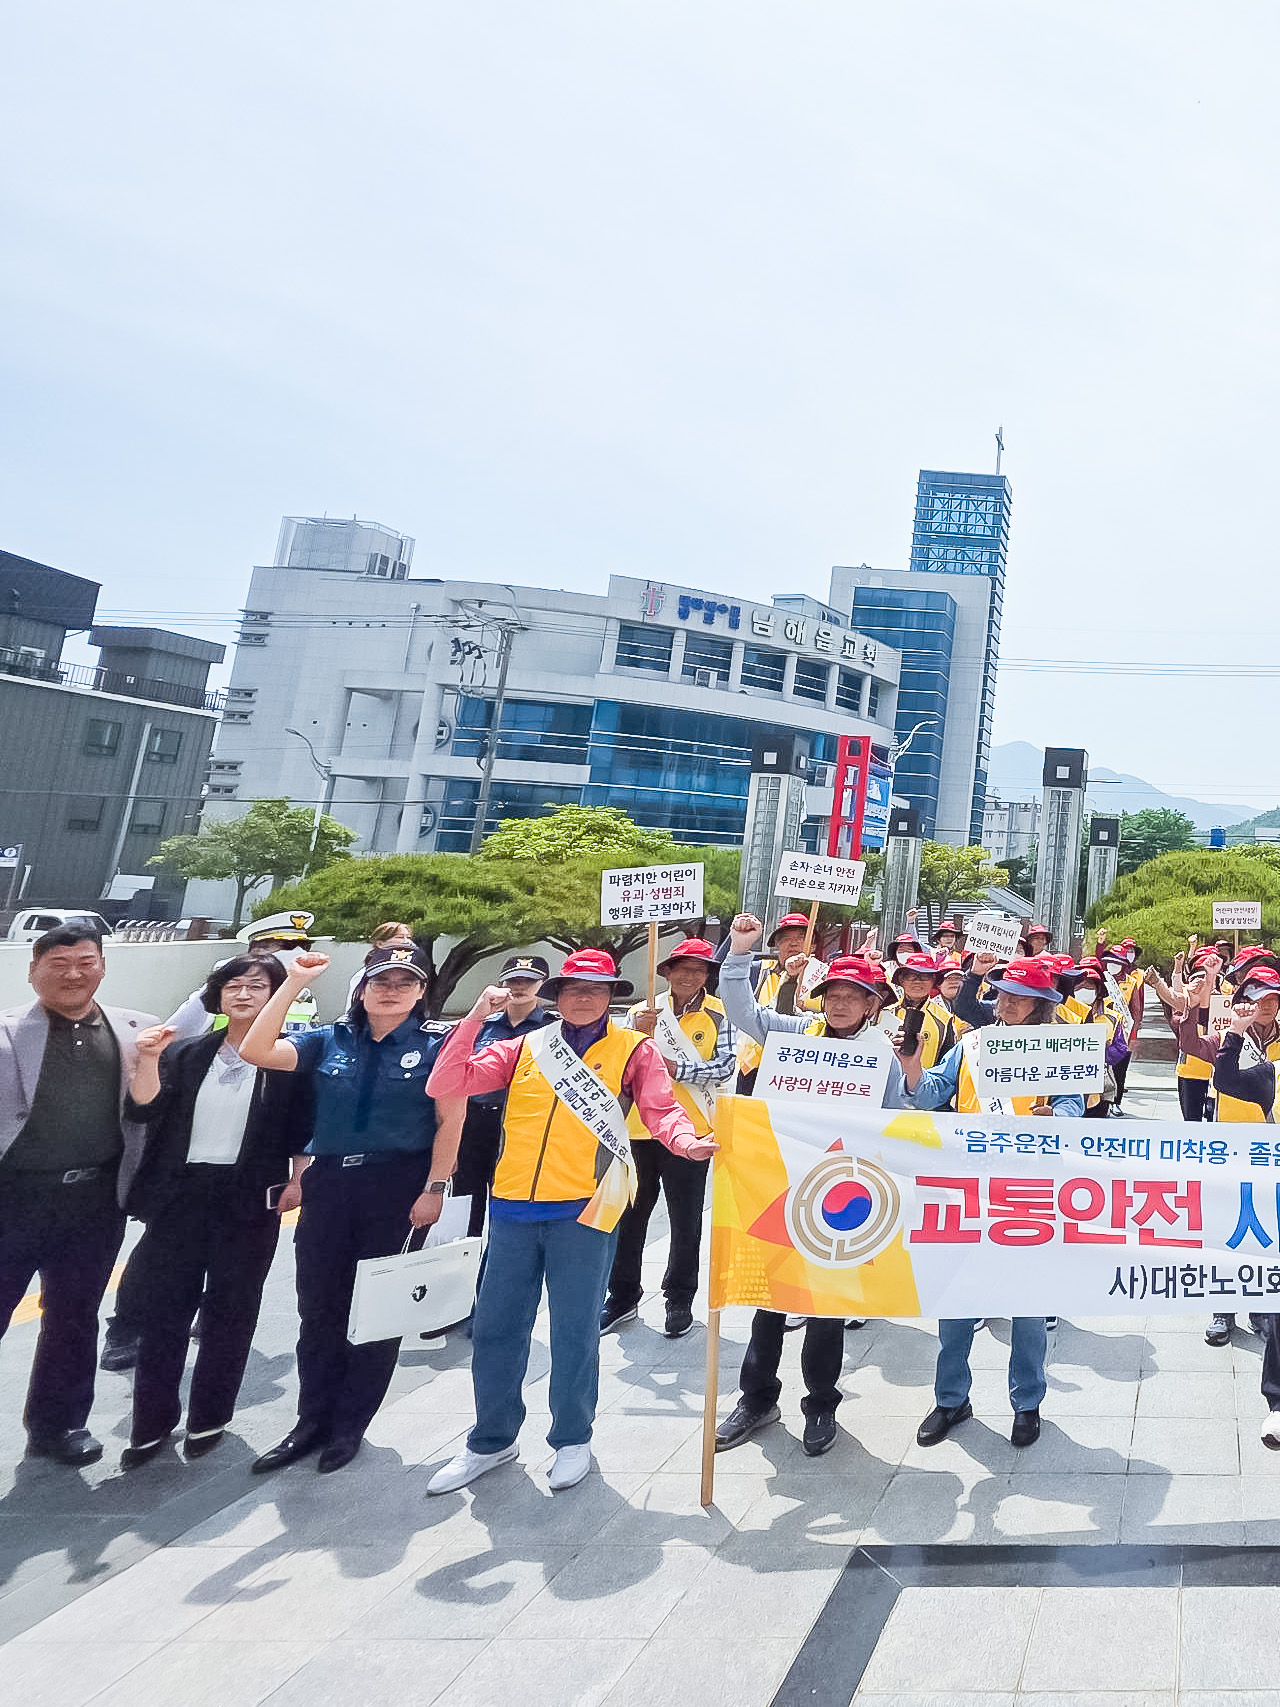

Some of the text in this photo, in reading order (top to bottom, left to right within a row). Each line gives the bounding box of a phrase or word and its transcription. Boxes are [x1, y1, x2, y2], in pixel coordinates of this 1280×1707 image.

[608, 868, 697, 887] 파렴치한 어린이
[788, 859, 856, 880] 손자·손녀 안전
[619, 887, 686, 902] 유괴·성범죄
[779, 876, 859, 897] 우리손으로 지키자!
[608, 901, 698, 919] 행위를 근절하자
[969, 936, 989, 950] 어린이
[986, 1037, 1042, 1055] 양보하고
[1045, 1037, 1100, 1054] 배려하는
[776, 1046, 879, 1070] 공경의 마음으로
[984, 1064, 1100, 1084] 아름다운 교통문화
[768, 1075, 873, 1098] 사랑의 살핌으로
[553, 1078, 598, 1123] 아름다운
[1080, 1134, 1151, 1162] 안전띠
[909, 1174, 1205, 1249] 교통안전
